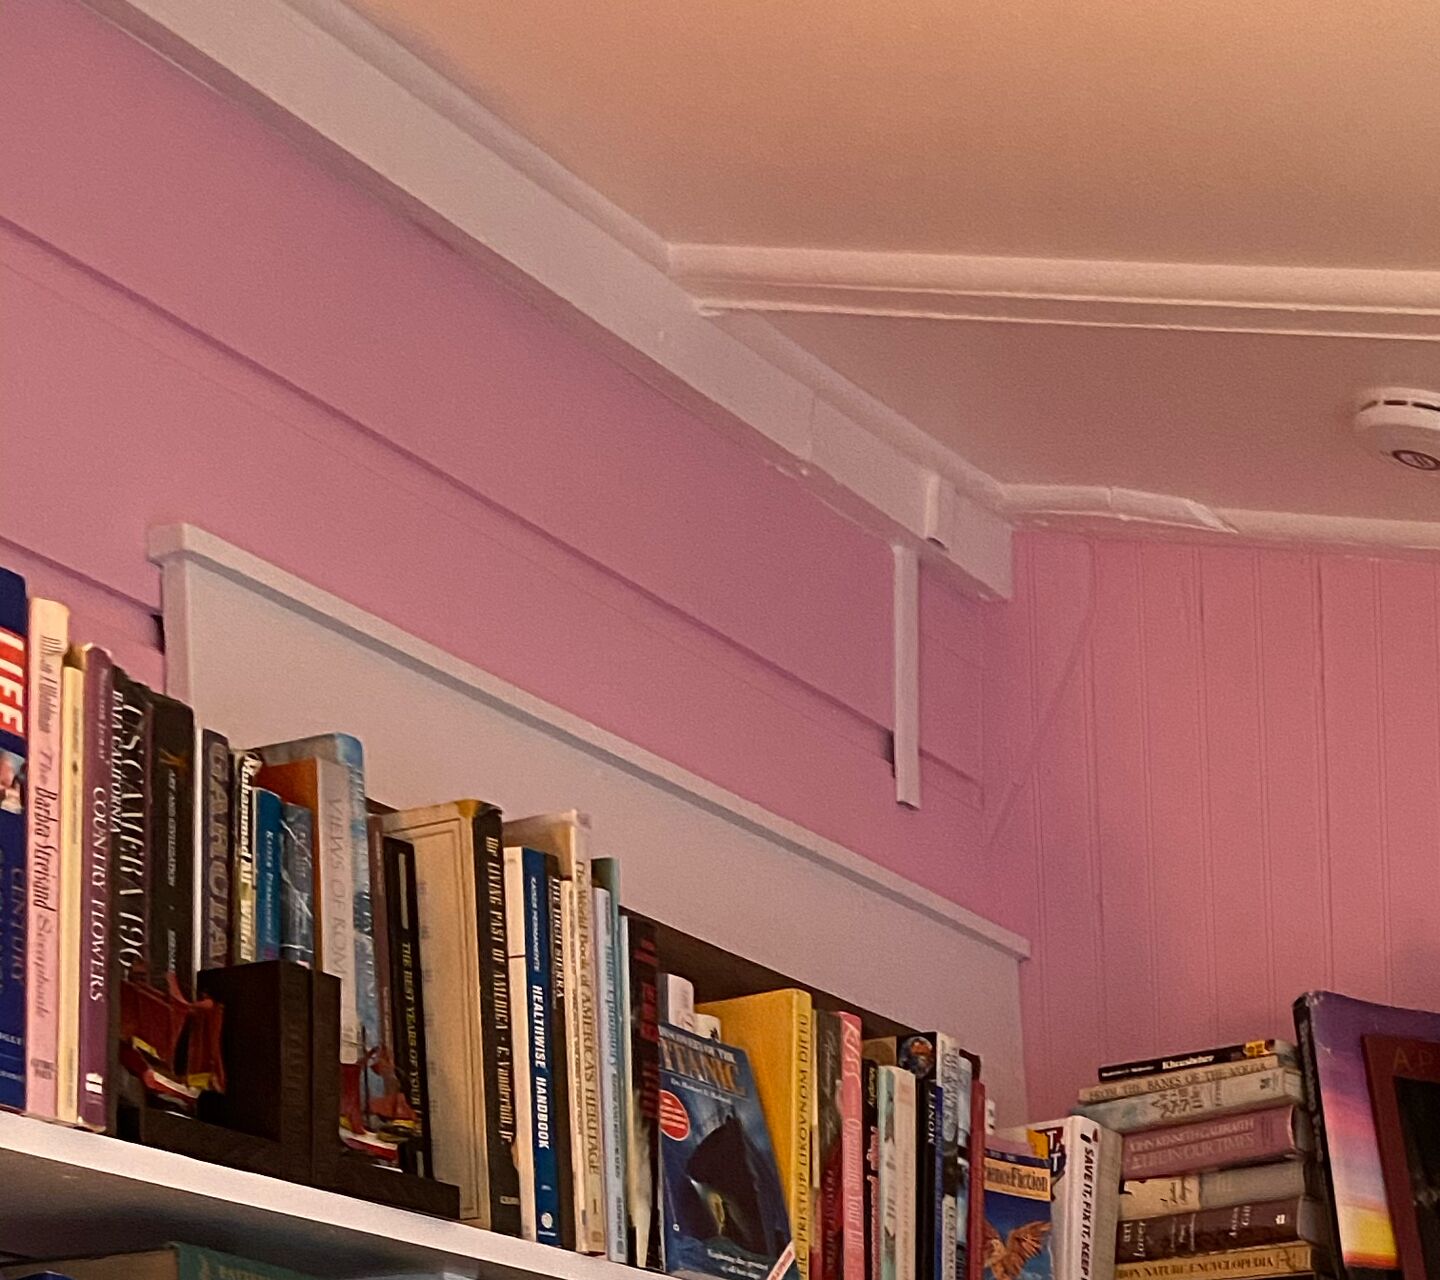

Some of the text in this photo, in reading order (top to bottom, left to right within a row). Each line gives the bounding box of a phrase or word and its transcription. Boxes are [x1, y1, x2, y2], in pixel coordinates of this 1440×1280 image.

[110, 736, 124, 834] CALIFORNIA
[239, 753, 260, 859] Muhammad
[33, 786, 59, 912] Barbra Streisand
[119, 759, 145, 897] CAMERA
[167, 818, 177, 886] CIVILIZATION
[208, 742, 229, 958] GARCIA
[326, 798, 348, 913] VIEWS OF
[89, 786, 108, 1002] COUNTRY FLOWERS
[264, 871, 275, 943] PERMANENTE
[531, 876, 542, 972] KAISER PERMANENTE
[577, 889, 589, 930] World
[487, 863, 509, 1030] LIVING PAST OF AMERICA
[551, 878, 566, 999] THE HIGH SIERRA
[579, 934, 589, 968] Book
[401, 942, 420, 1105] THE BEST YEARS OF YOUR
[532, 986, 551, 1150] HEALTHWISE HANDBOOK
[867, 1066, 877, 1108] Murphy
[1089, 1087, 1118, 1101] FROM
[1122, 1083, 1142, 1096] THE
[1147, 1076, 1182, 1091] BANKS
[1185, 1073, 1201, 1084] OF
[1205, 1068, 1228, 1082] THE
[585, 1088, 600, 1175] HERITAGE
[796, 1013, 809, 1242] PRISTUP LIKOVNOM DJELU
[927, 1090, 937, 1145] MONET
[1156, 1129, 1201, 1146] KENNETH
[1202, 1119, 1255, 1139] GALBRAITH
[1216, 1134, 1256, 1153] TIMES
[843, 1118, 864, 1251] Organizing Your Life
[1010, 1166, 1048, 1193] Fiction
[1083, 1183, 1093, 1201] IT,
[1085, 1147, 1096, 1182] SAVE
[1081, 1225, 1091, 1241] IT,
[1082, 1202, 1092, 1224] FIX
[1080, 1242, 1091, 1277] KEEP
[1144, 1255, 1274, 1277] NATURE ENCYCLOPEDIA
